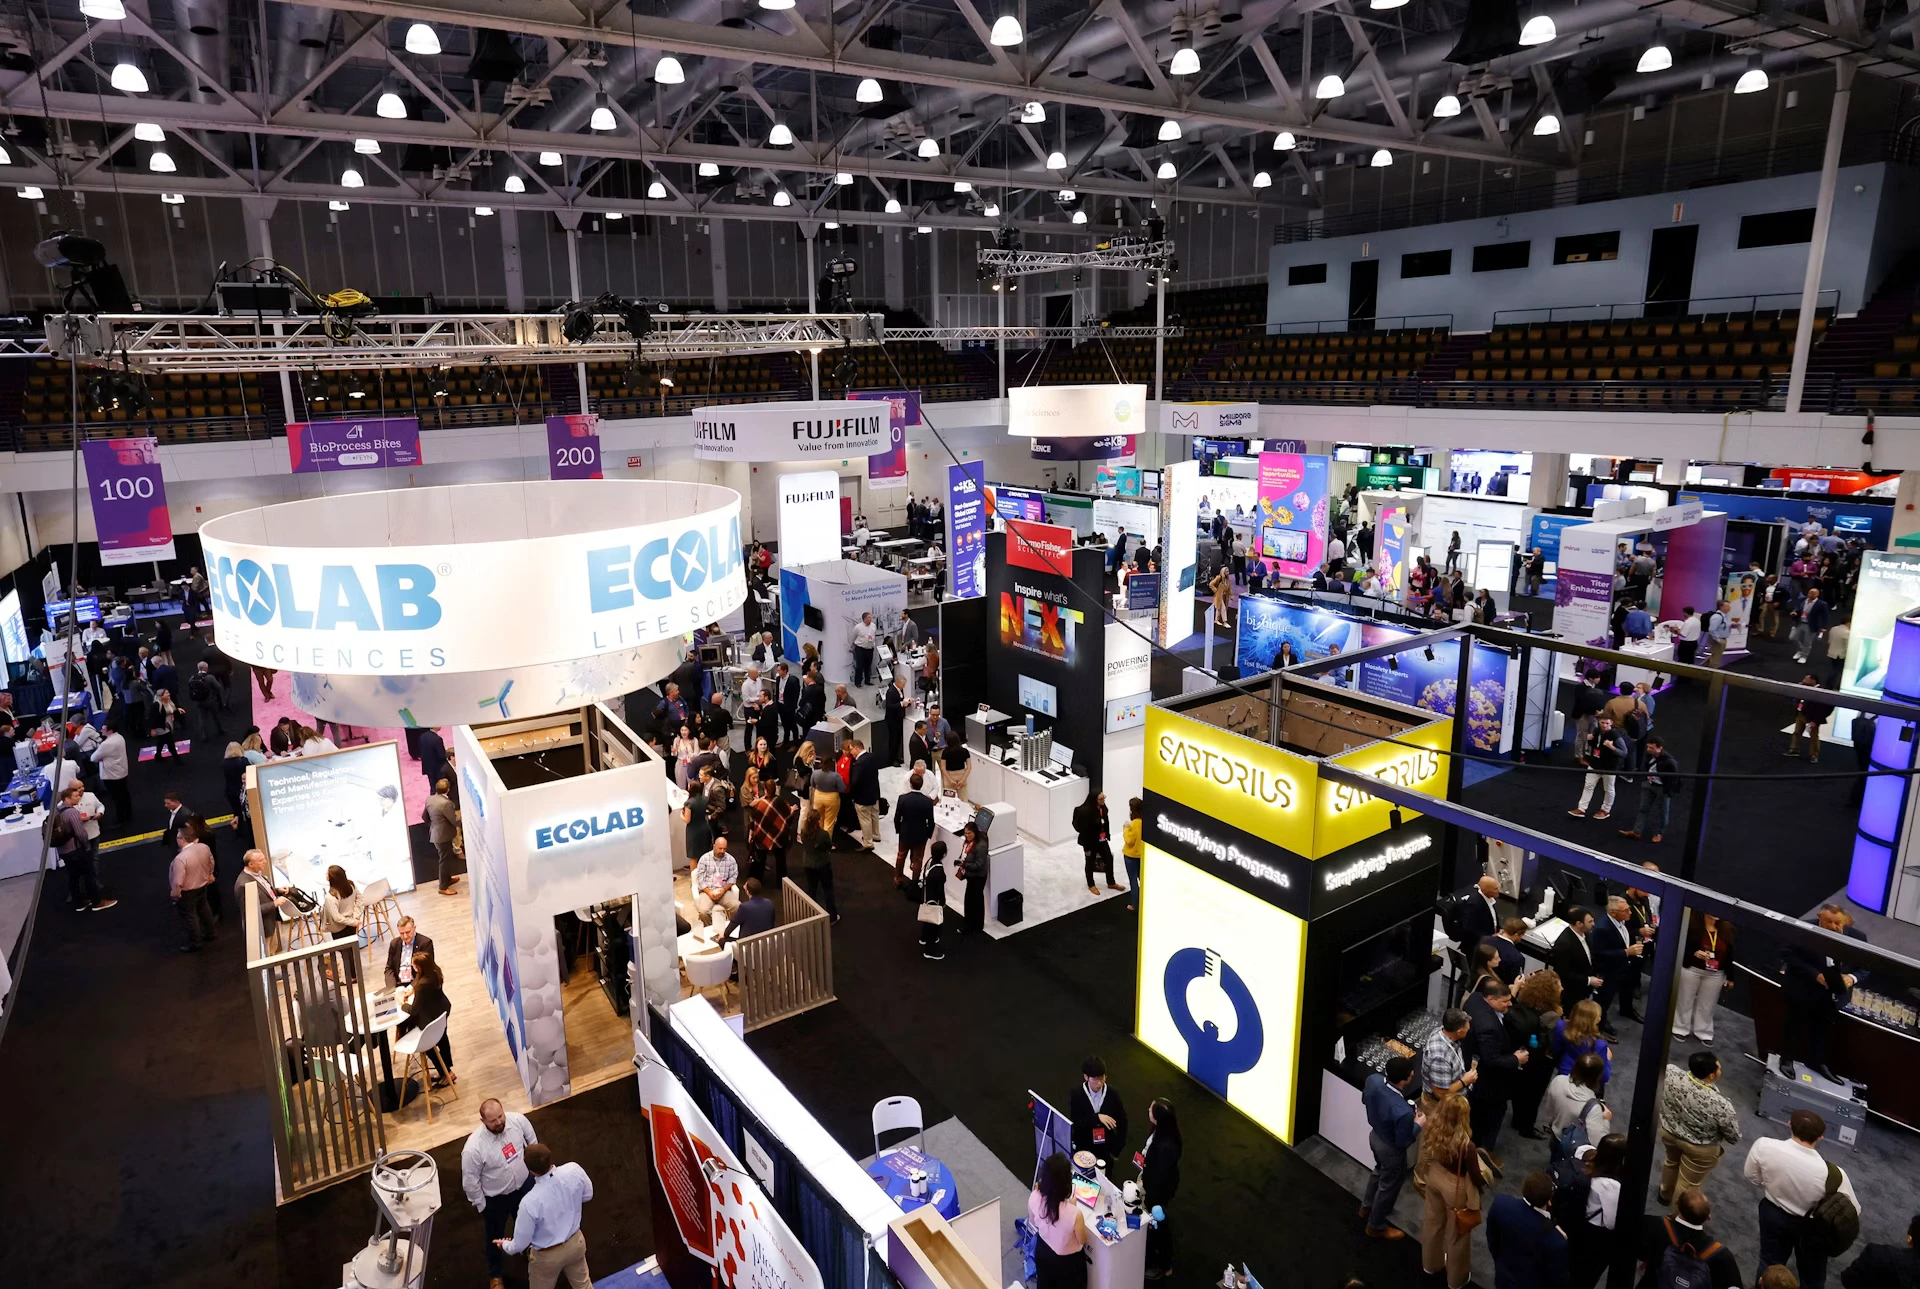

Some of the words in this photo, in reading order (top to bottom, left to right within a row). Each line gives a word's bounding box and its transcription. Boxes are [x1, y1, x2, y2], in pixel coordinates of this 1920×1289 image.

[793, 416, 880, 440] FUJIFILM
[309, 441, 372, 453] BioProcess
[373, 439, 401, 450] Bites
[704, 444, 734, 452] Innovation
[798, 443, 822, 451] Value
[824, 441, 844, 450] from
[846, 438, 878, 449] Innovation
[1275, 441, 1296, 453] 500
[556, 446, 595, 467] 200
[100, 477, 154, 501] 100
[785, 489, 835, 504] FUJIFILM
[587, 510, 744, 614] ECOLA
[1870, 558, 1900, 569] Your
[1570, 584, 1609, 595] Enhancer
[1591, 580, 1610, 588] Titer
[1014, 581, 1043, 599] Inspire
[1043, 590, 1068, 606] what's
[1000, 591, 1084, 651] NEXT
[593, 615, 669, 649] LIFE
[255, 641, 446, 668] SCIENCES
[1107, 654, 1149, 671] POWERING
[1244, 660, 1255, 668] Test
[1364, 662, 1388, 674] Biosafety
[1389, 668, 1409, 679] Experts
[268, 773, 310, 787] Technical,
[1159, 735, 1292, 808] SARTORIUS
[270, 788, 286, 797] and
[272, 792, 310, 806] Expertise
[535, 806, 645, 850] ECOLAB
[1156, 813, 1227, 861] Simplifying
[1227, 845, 1291, 889] Progress
[1325, 853, 1387, 891] Simplifying
[1386, 834, 1432, 865] Progress
